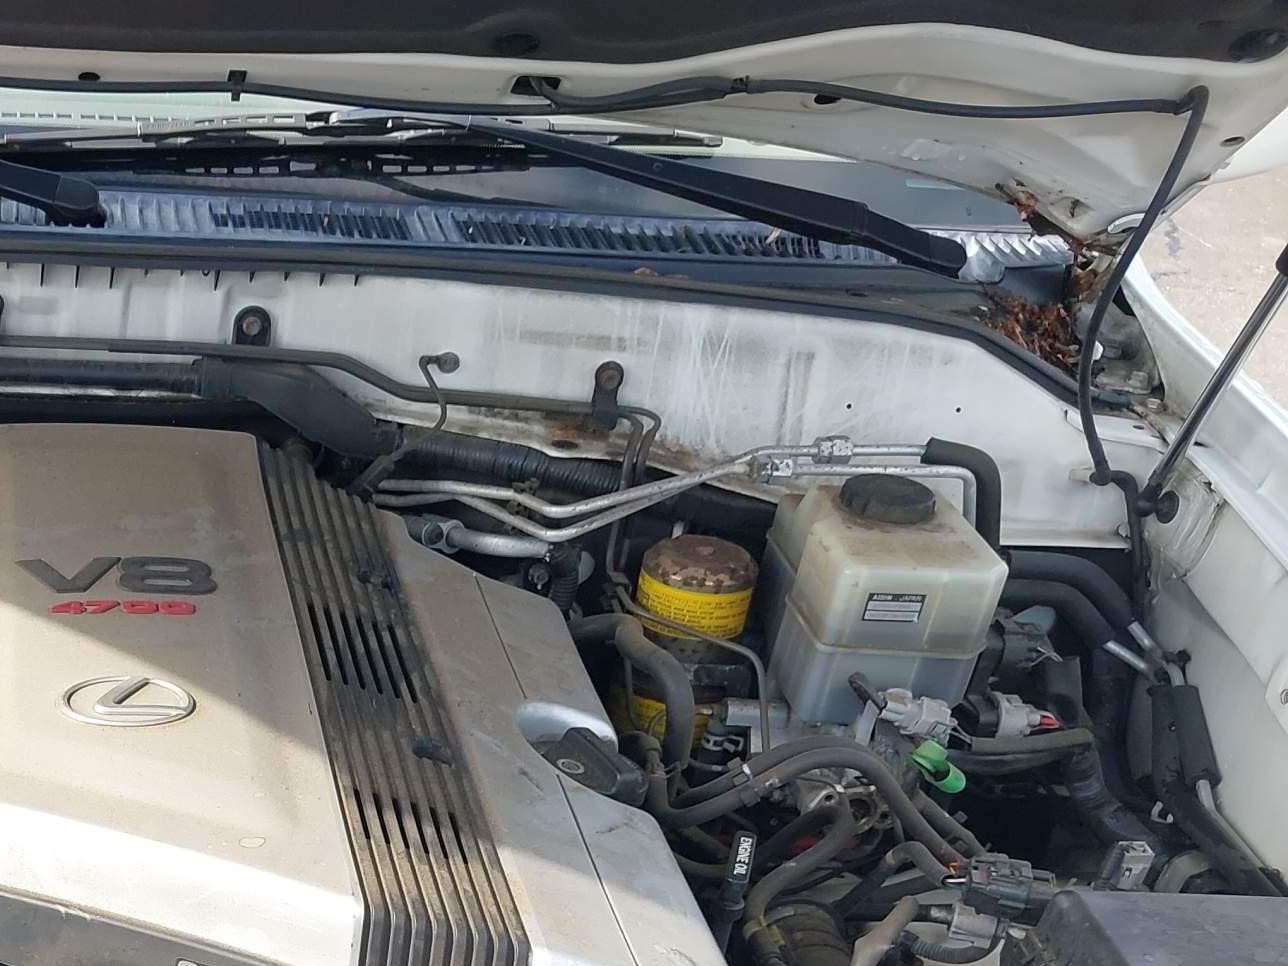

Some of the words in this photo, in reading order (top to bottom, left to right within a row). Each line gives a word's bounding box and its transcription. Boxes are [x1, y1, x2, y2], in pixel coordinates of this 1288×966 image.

[15, 556, 217, 595] V8
[48, 600, 196, 616] 4700
[736, 836, 752, 864] ENGINE
[733, 863, 748, 875] OIL
